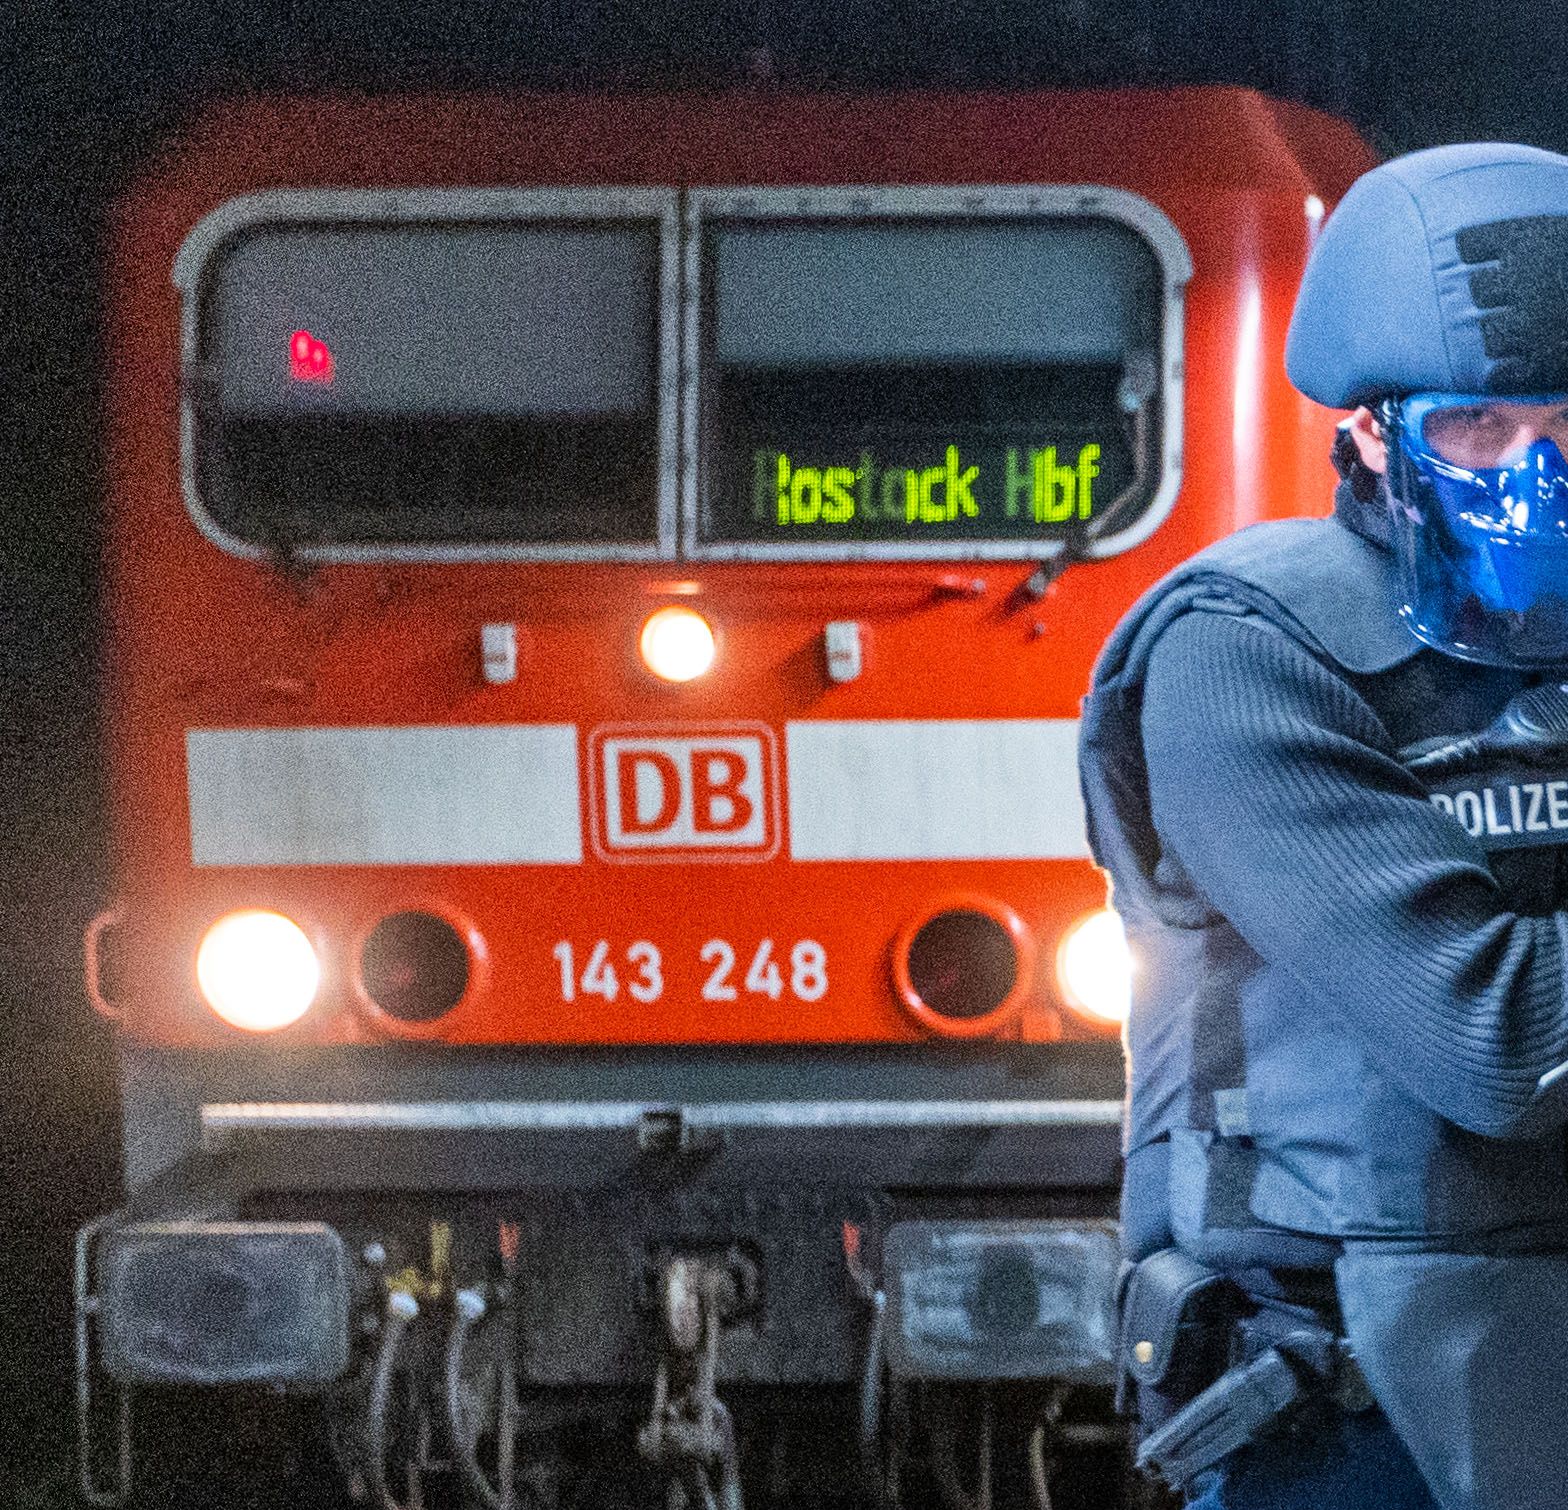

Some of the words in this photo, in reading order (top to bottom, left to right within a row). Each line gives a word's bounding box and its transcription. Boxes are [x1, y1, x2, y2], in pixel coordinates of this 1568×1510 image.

[1004, 443, 1102, 523] Hbf
[616, 748, 754, 836] DB
[553, 941, 664, 1004] 143
[701, 939, 829, 1003] 248
